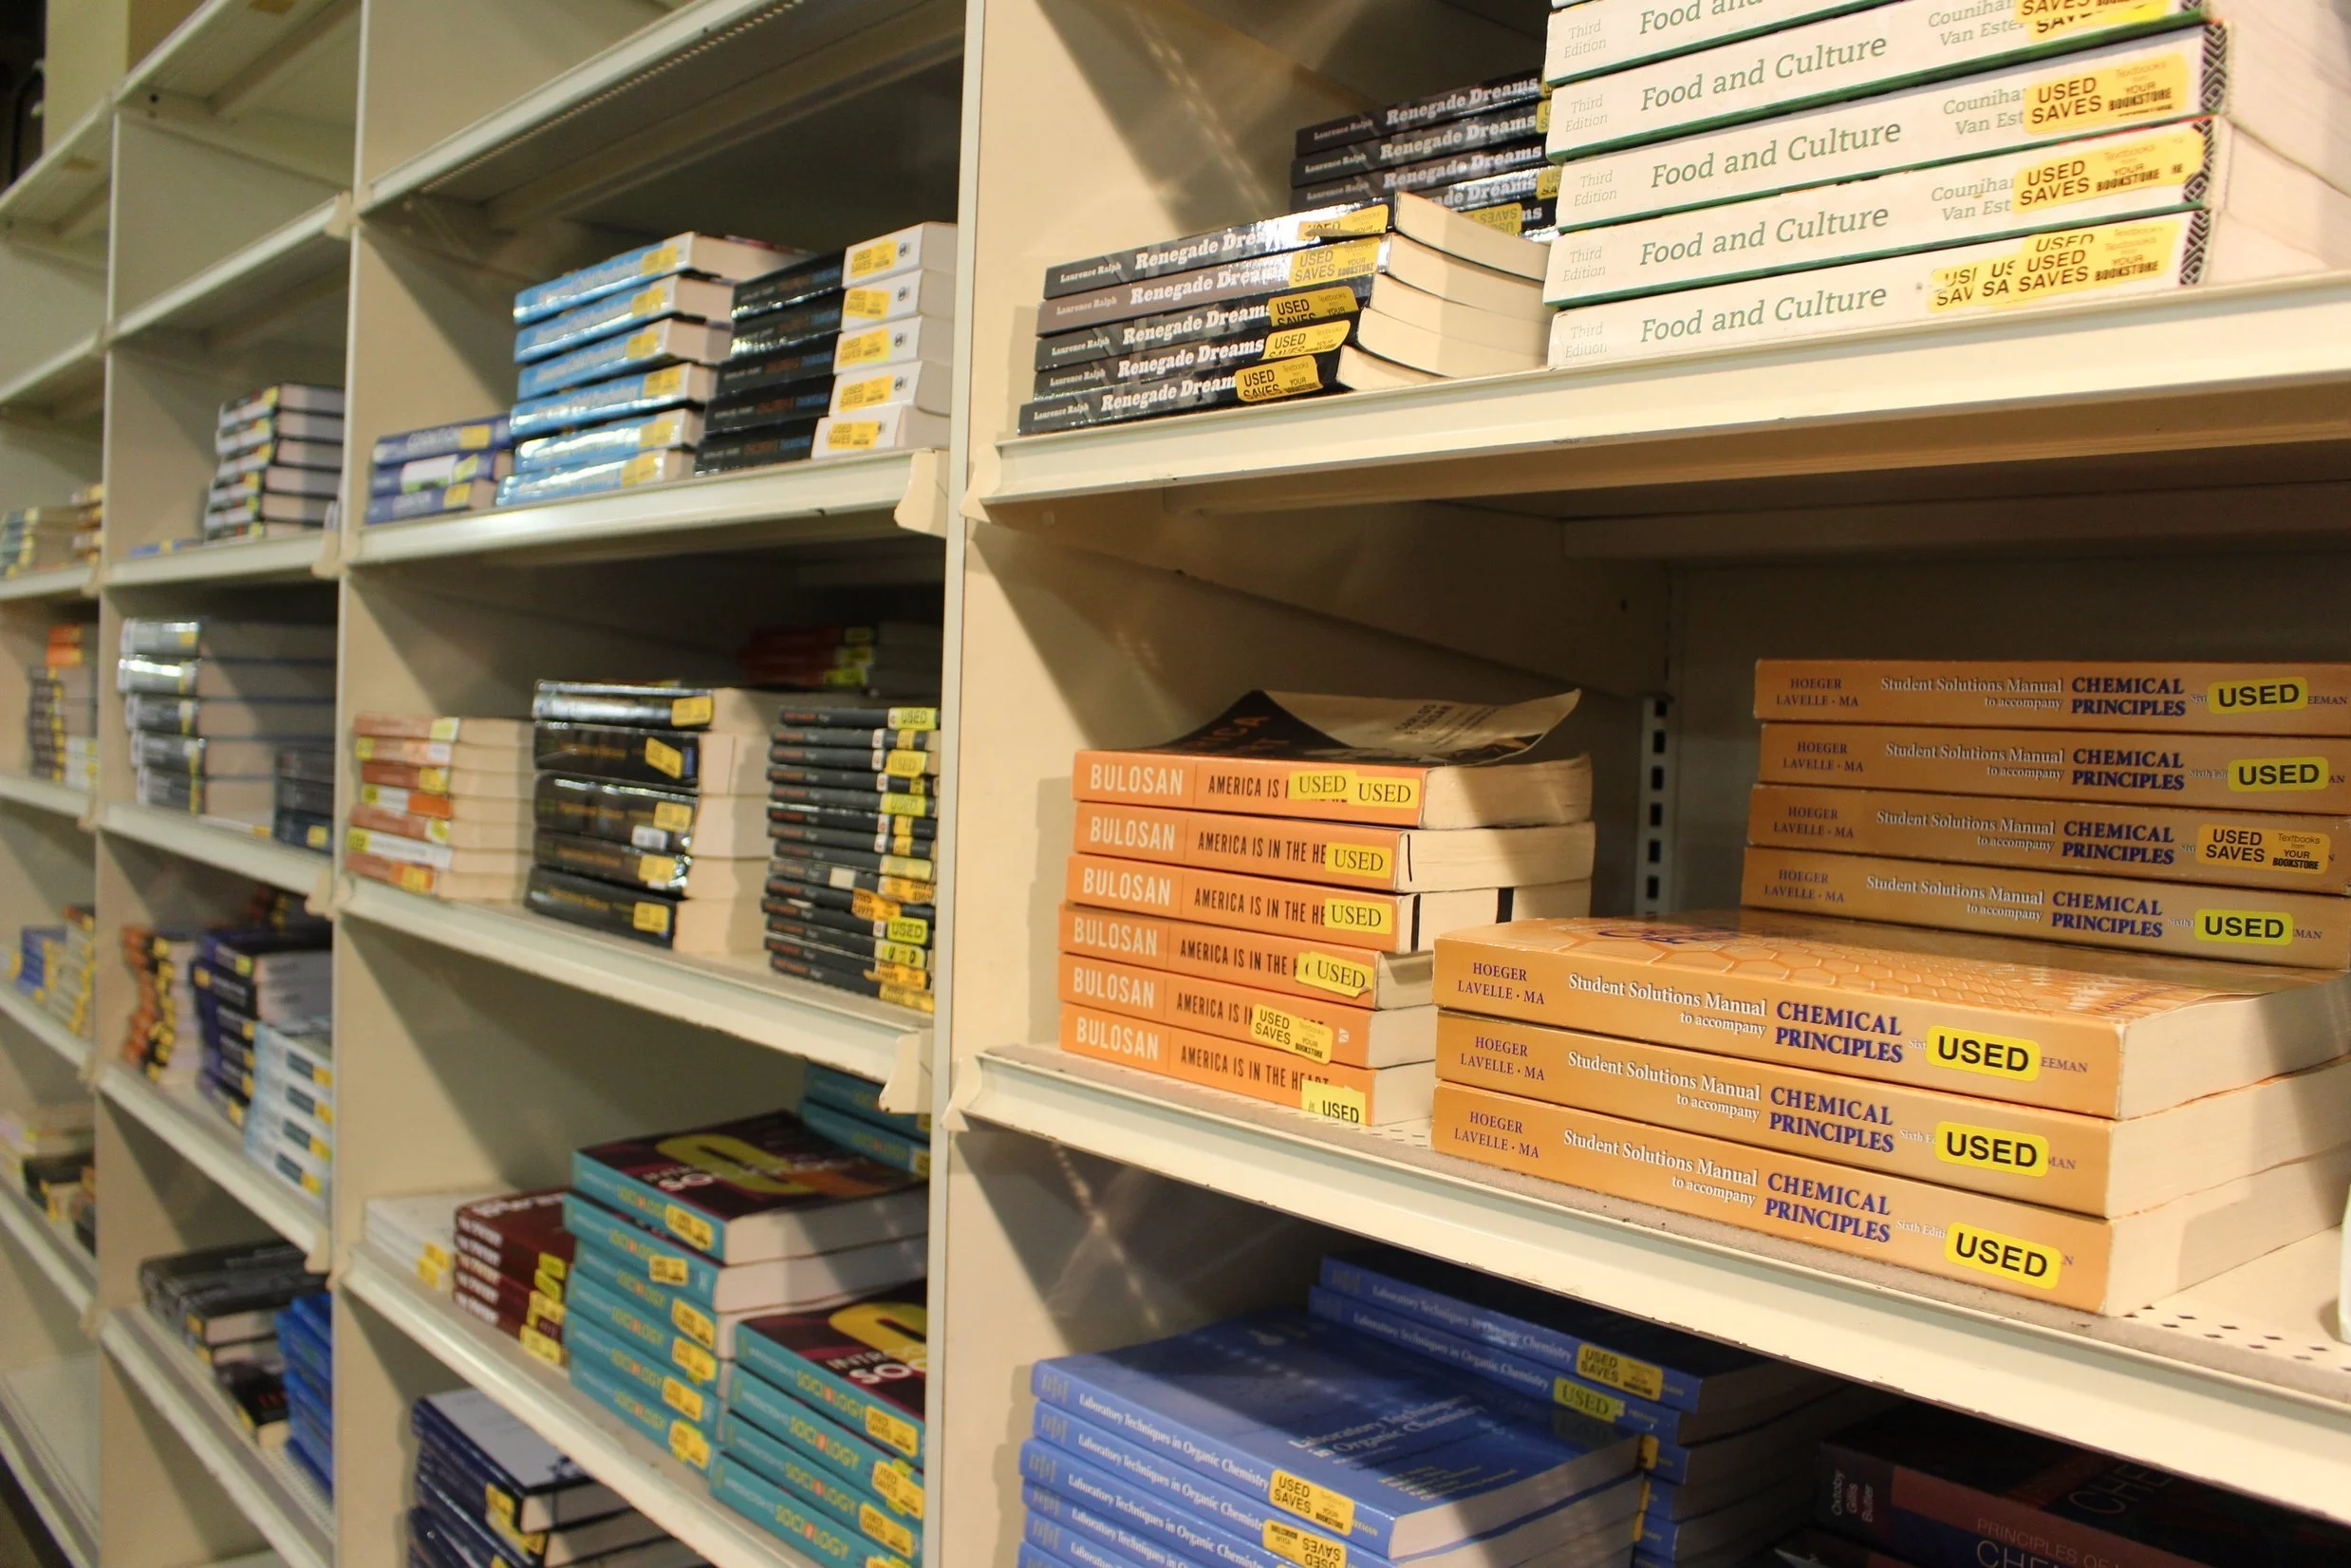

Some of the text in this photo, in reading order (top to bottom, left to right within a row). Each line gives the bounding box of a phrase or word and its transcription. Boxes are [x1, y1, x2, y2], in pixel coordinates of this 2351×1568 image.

[1641, 37, 1887, 111] Food and Culture
[1387, 77, 1538, 124] Renegade Dreams
[2038, 77, 2097, 103] USED
[2031, 95, 2102, 124] SAVES
[1381, 114, 1536, 159] Renegade Dreams
[1383, 144, 1541, 190] Renegade Dreams
[1651, 121, 1901, 188] Food and Culture
[2027, 159, 2086, 187] USED
[2020, 177, 2090, 206] SAVES
[1639, 208, 1889, 266] Food and Culture
[1135, 241, 1218, 271] Renegade
[1300, 250, 1334, 267] USED
[2027, 250, 2086, 272] USED
[1295, 264, 1335, 282] SAVES
[2018, 267, 2089, 291] SAVES
[1130, 275, 1212, 305] Renegade
[1277, 299, 1310, 315] USED
[1640, 288, 1887, 342] Food and Culture
[1123, 317, 1202, 345] Renegade
[1275, 332, 1306, 349] USED
[1052, 340, 1088, 357] Laurence
[1118, 339, 1264, 379] Renegade Dreams
[1050, 371, 1086, 387] Laurence
[1243, 369, 1275, 387] USED
[1100, 386, 1178, 412] Renegade
[1034, 406, 1070, 420] Laurence
[1790, 678, 1842, 690] HOEGER
[1881, 678, 2062, 694] Student Solutions Manual
[2072, 677, 2184, 695] CHEMICAL
[2218, 683, 2300, 708] USED
[2070, 699, 2185, 717] PRINCIPLES
[1797, 741, 1847, 755] HOEGER
[1886, 743, 2064, 763] Student Solutions Manual
[2073, 748, 2184, 769] CHEMICAL
[1090, 763, 1184, 795] BULOSAN
[1208, 775, 1262, 797] AMERICA
[2072, 770, 2185, 791] PRINCIPLES
[2239, 764, 2320, 786] USED
[1299, 775, 1411, 803] USED USED
[1788, 806, 1838, 820] HOEGER
[1876, 809, 2055, 836] Student Solutions Manual
[1090, 815, 1175, 850] BULOSAN
[1198, 831, 1247, 855] AMERICA
[2063, 820, 2174, 843] CHEMICAL
[2213, 828, 2262, 847] USED
[2277, 832, 2321, 845] Textbooks
[1334, 849, 1383, 871] USED
[2062, 841, 2174, 866] PRINCIPLES
[2206, 844, 2266, 863] SAVES
[2272, 857, 2320, 870] BOOKSTORE
[2285, 849, 2310, 860] YOUR
[1083, 867, 1170, 906] BULOSAN
[1779, 868, 1829, 884] HOEGER
[1195, 888, 1244, 914] AMERICA
[1867, 874, 2044, 906] Student Solutions Manual
[1332, 904, 1381, 926] USED
[2052, 890, 2163, 918] CHEMICAL
[891, 922, 924, 939] USED
[1073, 917, 1157, 957] BULOSAN
[2051, 911, 2163, 939] PRINCIPLES
[2205, 915, 2284, 939] USED
[1180, 939, 1229, 966] AMERICA
[1472, 961, 1527, 982] HOEGER
[1073, 967, 1154, 1009] BULOSAN
[1457, 980, 1513, 1000] LAVELLE
[1569, 973, 1766, 1017] Student Solutions Manual
[1177, 993, 1222, 1019] AMERICA
[1259, 1008, 1290, 1030] USED
[1776, 1000, 1901, 1036] CHEMICAL
[1077, 1016, 1159, 1061] BULOSAN
[1255, 1021, 1291, 1045] SAVES
[1775, 1026, 1903, 1064] PRINCIPLES
[1181, 1045, 1229, 1073] AMERICA
[1475, 1036, 1528, 1058] HOEGER
[1938, 1035, 2028, 1073] USED
[1461, 1052, 1514, 1074] LAVELLE
[1568, 1051, 1761, 1102] Student Solutions Manual
[1770, 1085, 1894, 1127] CHEMICAL
[1469, 1110, 1523, 1135] HOEGER
[1768, 1111, 1894, 1154] PRINCIPLES
[1454, 1127, 1508, 1152] LAVELLE
[1563, 1129, 1620, 1157] Student
[1899, 1129, 1925, 1143] Sixth
[1947, 1130, 2038, 1168] USED
[1766, 1172, 1891, 1216] CHEMICAL
[1764, 1196, 1891, 1244] PRINCIPLES
[1894, 1219, 1920, 1235] Sixth
[1955, 1231, 2047, 1279] USED
[1586, 1349, 1618, 1369] USED
[1581, 1359, 1621, 1386] SAVES
[1079, 1392, 1270, 1492] Laboratory Techniques Organic Chemistry
[1078, 1433, 1219, 1511] Laboratory Techniques Organic
[1278, 1475, 1311, 1499] USED
[1068, 1473, 1216, 1553] Laboratory Techniques Organic
[1274, 1487, 1312, 1515] SAVES
[1072, 1507, 1166, 1563] Laboratory Techniques
[1976, 1518, 2077, 1562] PRINCIPLES
